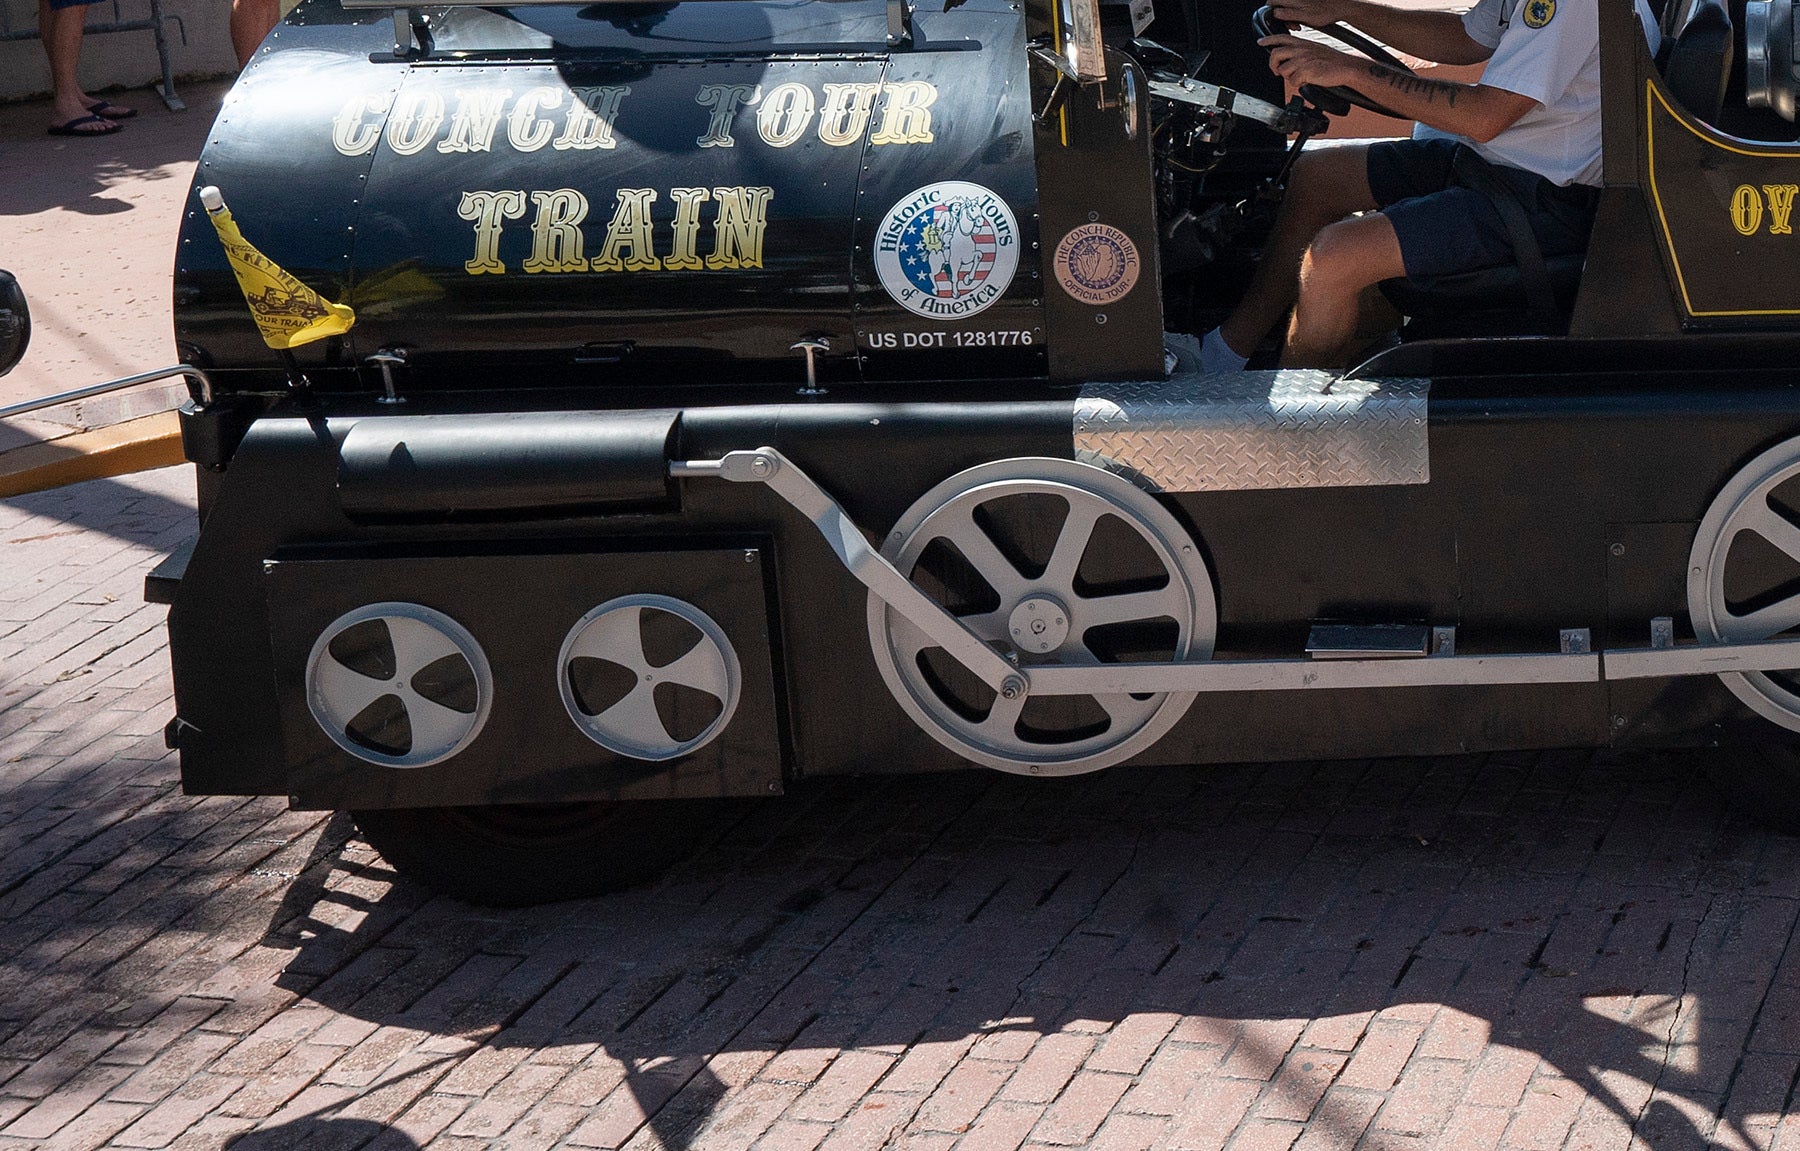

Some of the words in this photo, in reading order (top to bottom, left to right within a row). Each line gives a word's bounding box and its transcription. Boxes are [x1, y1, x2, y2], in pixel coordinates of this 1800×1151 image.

[333, 85, 631, 155] CONCH
[695, 81, 939, 148] TOUR
[457, 186, 774, 274] TRAIN
[880, 189, 941, 252] Historic
[979, 194, 1013, 247] Tours
[243, 253, 273, 270] KEY
[1058, 245, 1069, 264] THE
[1065, 226, 1103, 246] CONCH
[1105, 227, 1137, 267] REPUBLIC
[901, 287, 919, 301] of
[920, 282, 1000, 314] America
[1064, 279, 1104, 300] OFFICIAL
[1106, 281, 1129, 298] TOUR
[869, 333, 897, 348] US
[904, 332, 946, 348] DOT
[953, 331, 1033, 346] 1281776
